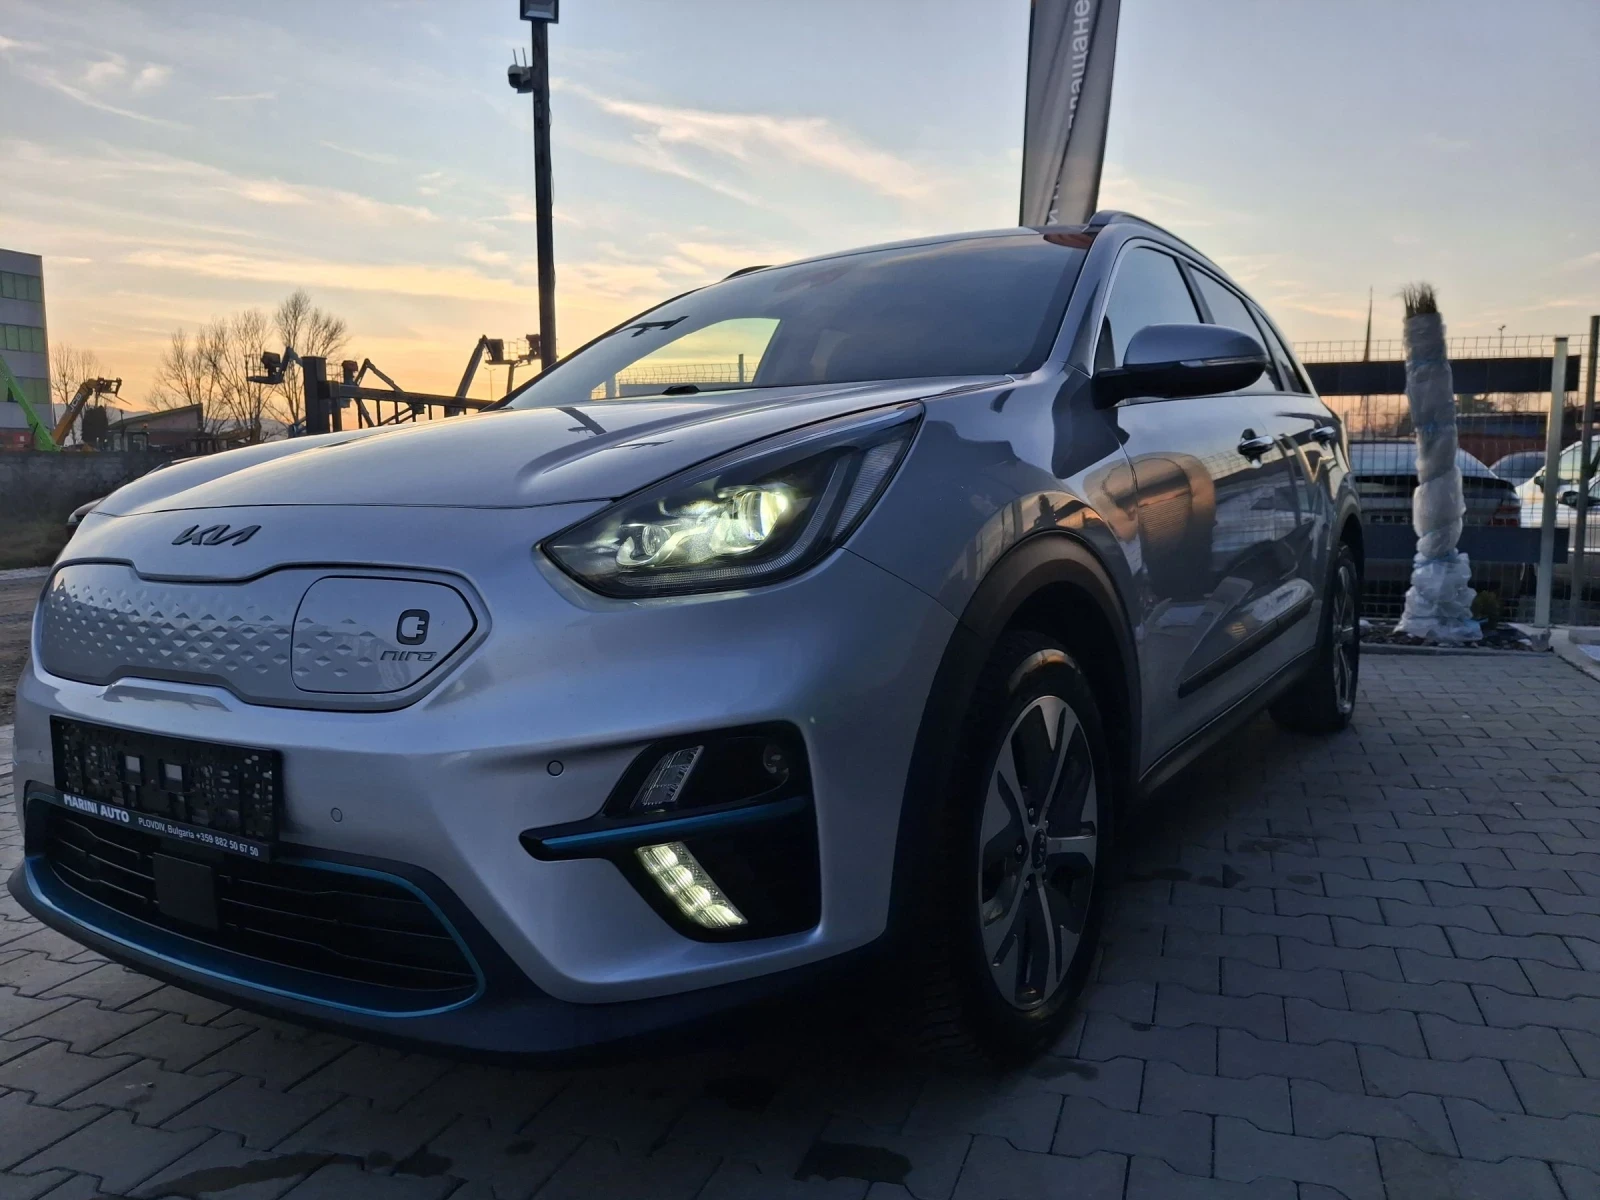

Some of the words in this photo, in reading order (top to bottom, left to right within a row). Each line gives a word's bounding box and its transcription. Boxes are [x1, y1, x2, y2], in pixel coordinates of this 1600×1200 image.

[1067, 0, 1090, 129] лащане
[70, 393, 82, 412] JCB
[171, 524, 262, 546] KIA
[63, 793, 98, 814] MARINI
[100, 804, 129, 823] AUTO
[167, 824, 194, 838] Bulgaria
[196, 832, 213, 844] +359
[214, 837, 229, 848] 882
[229, 840, 239, 851] 50
[239, 843, 248, 853] 67
[249, 846, 259, 857] 50
